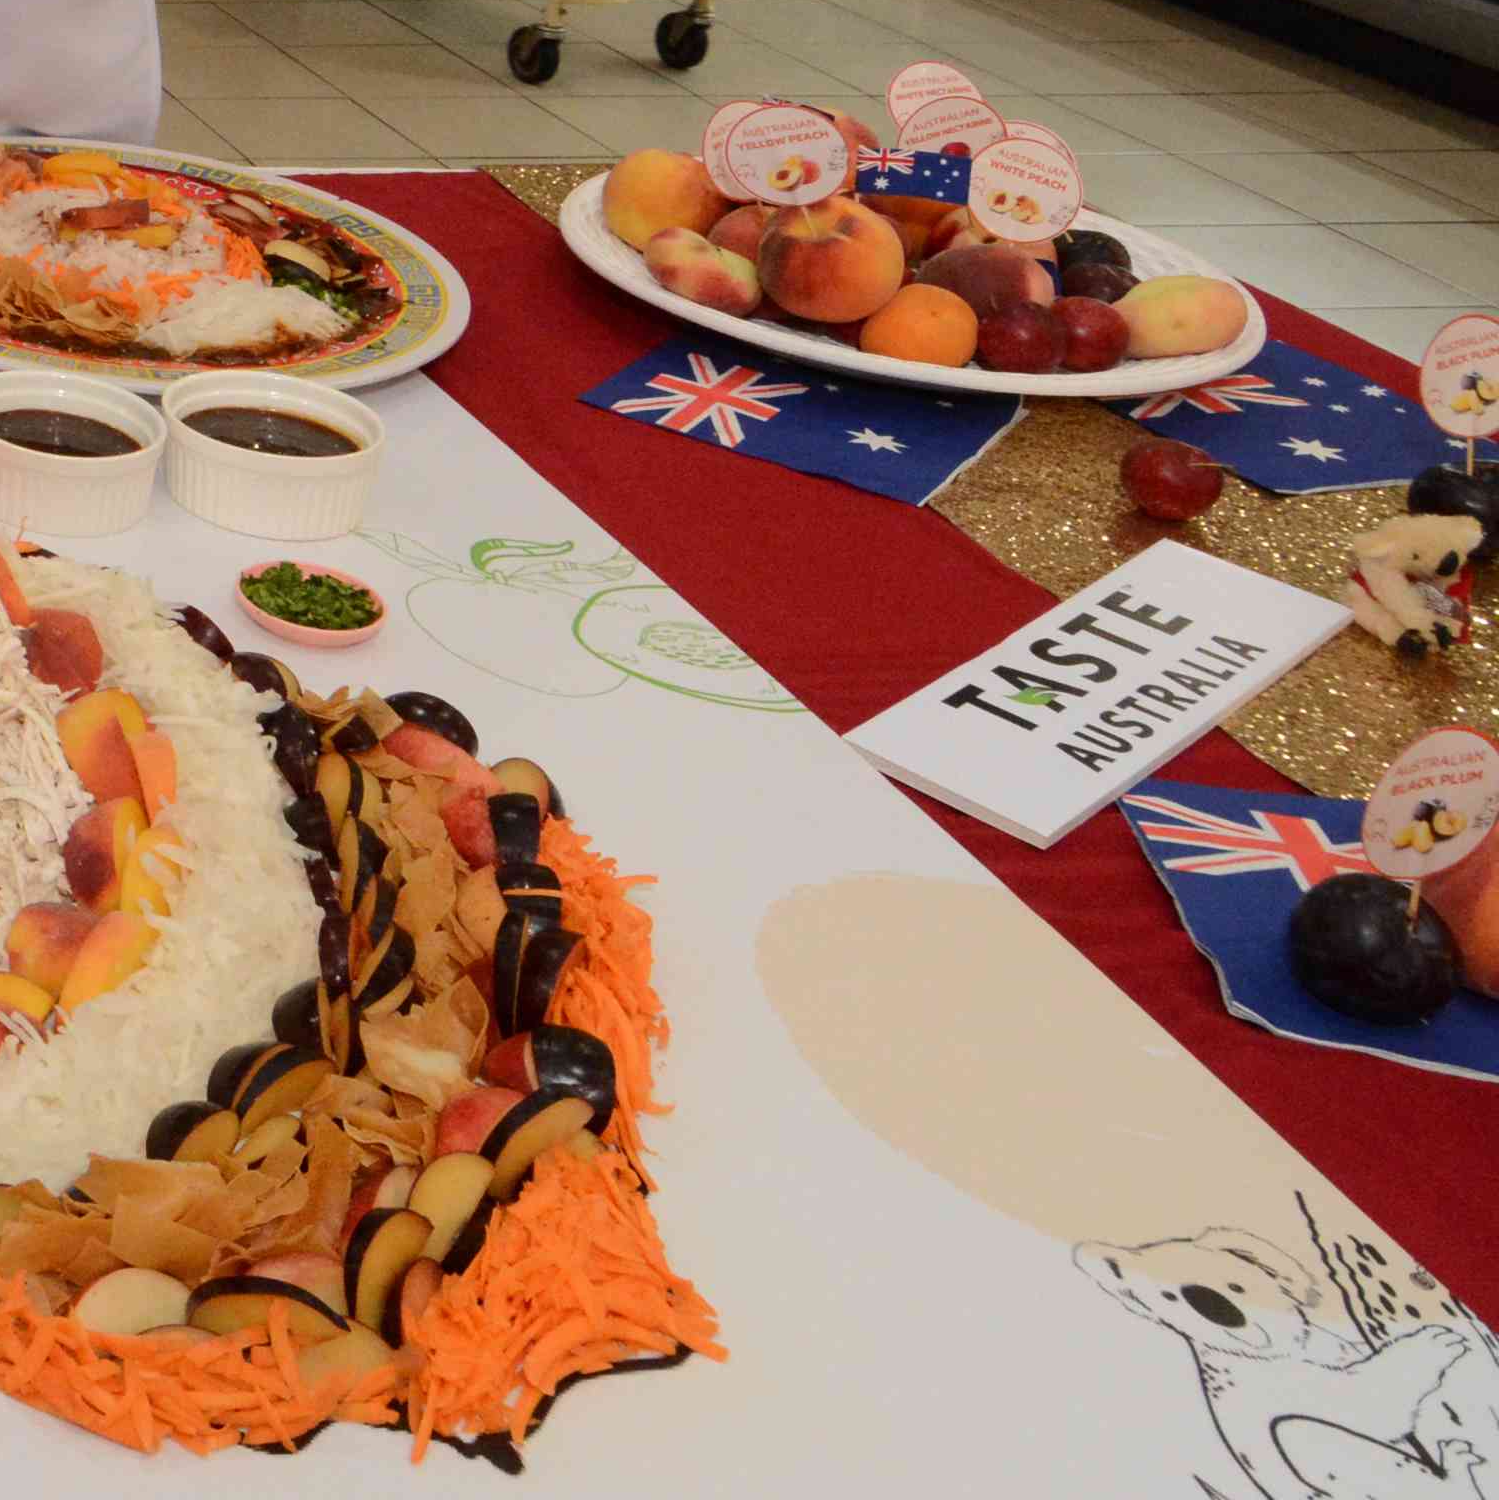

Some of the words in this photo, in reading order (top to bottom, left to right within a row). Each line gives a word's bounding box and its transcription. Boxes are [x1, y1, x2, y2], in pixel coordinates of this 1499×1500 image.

[736, 135, 786, 151] YELLOW
[788, 130, 830, 144] PEACH
[742, 118, 818, 138] AUSTRALIAN
[989, 158, 1025, 178] WHITE
[1027, 172, 1068, 192] PEACH
[941, 590, 1194, 732] TASTE
[1055, 635, 1267, 773] AUSTRALIA
[1395, 750, 1486, 778] AUSTRALIAN
[1391, 774, 1434, 797] BLACK
[1439, 770, 1484, 786] PLUM
